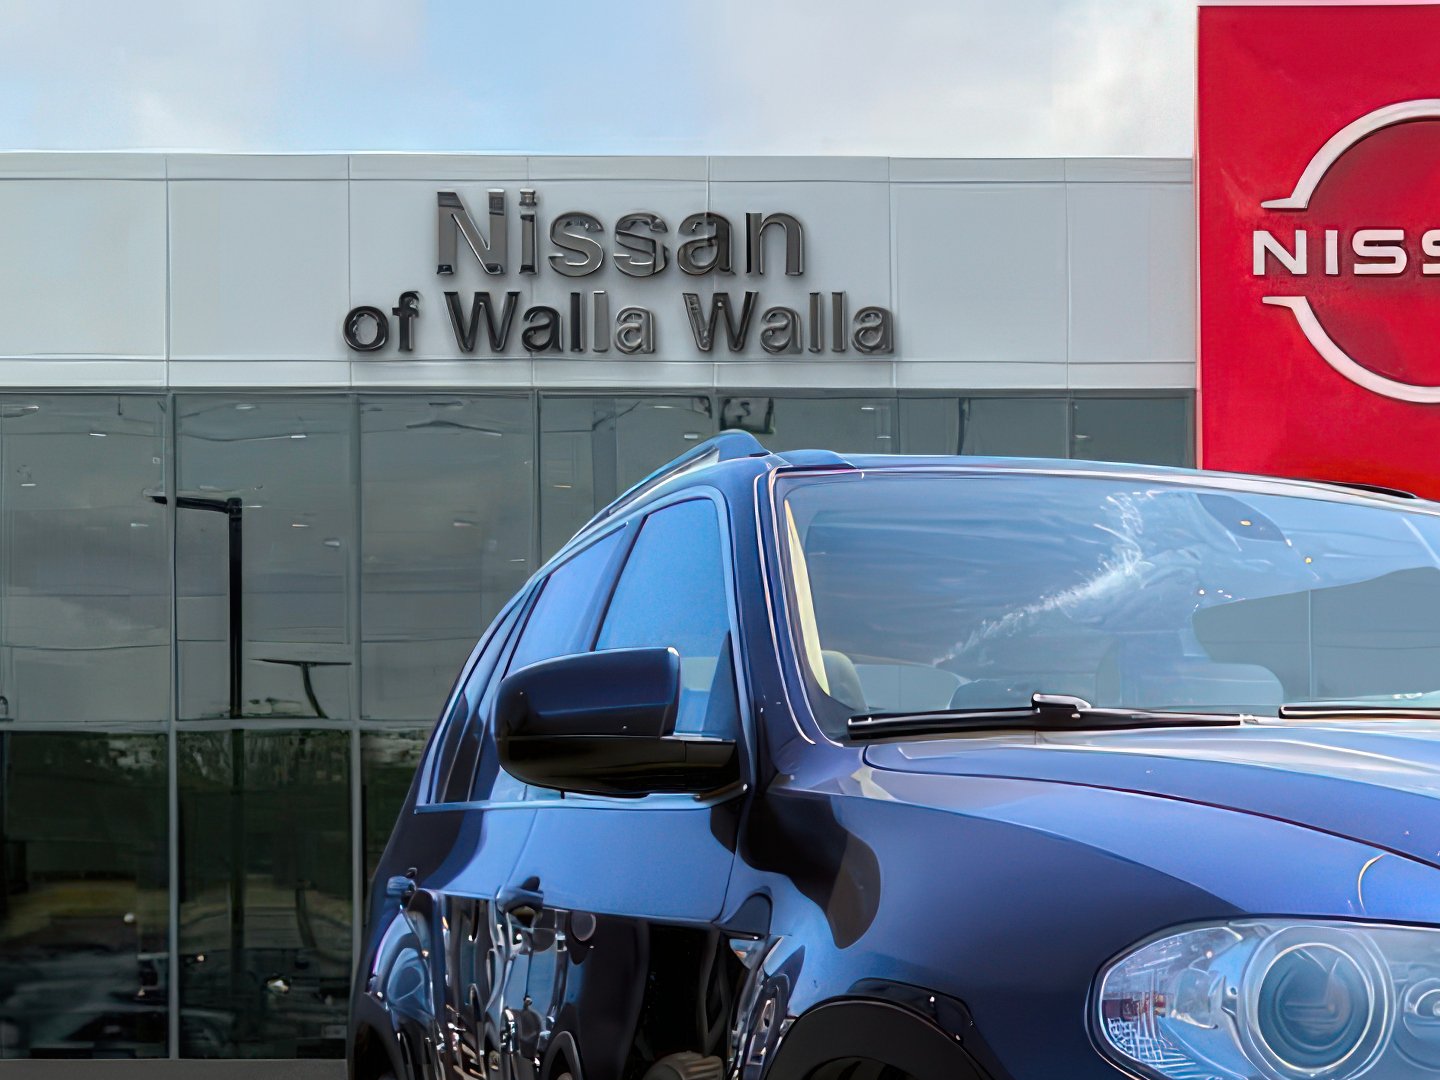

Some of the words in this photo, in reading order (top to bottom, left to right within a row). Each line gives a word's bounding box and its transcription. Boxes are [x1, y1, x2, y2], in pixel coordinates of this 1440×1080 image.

[436, 188, 805, 278] Nissan
[343, 290, 420, 353] of
[444, 290, 656, 354] Walla
[682, 290, 895, 355] Walla
